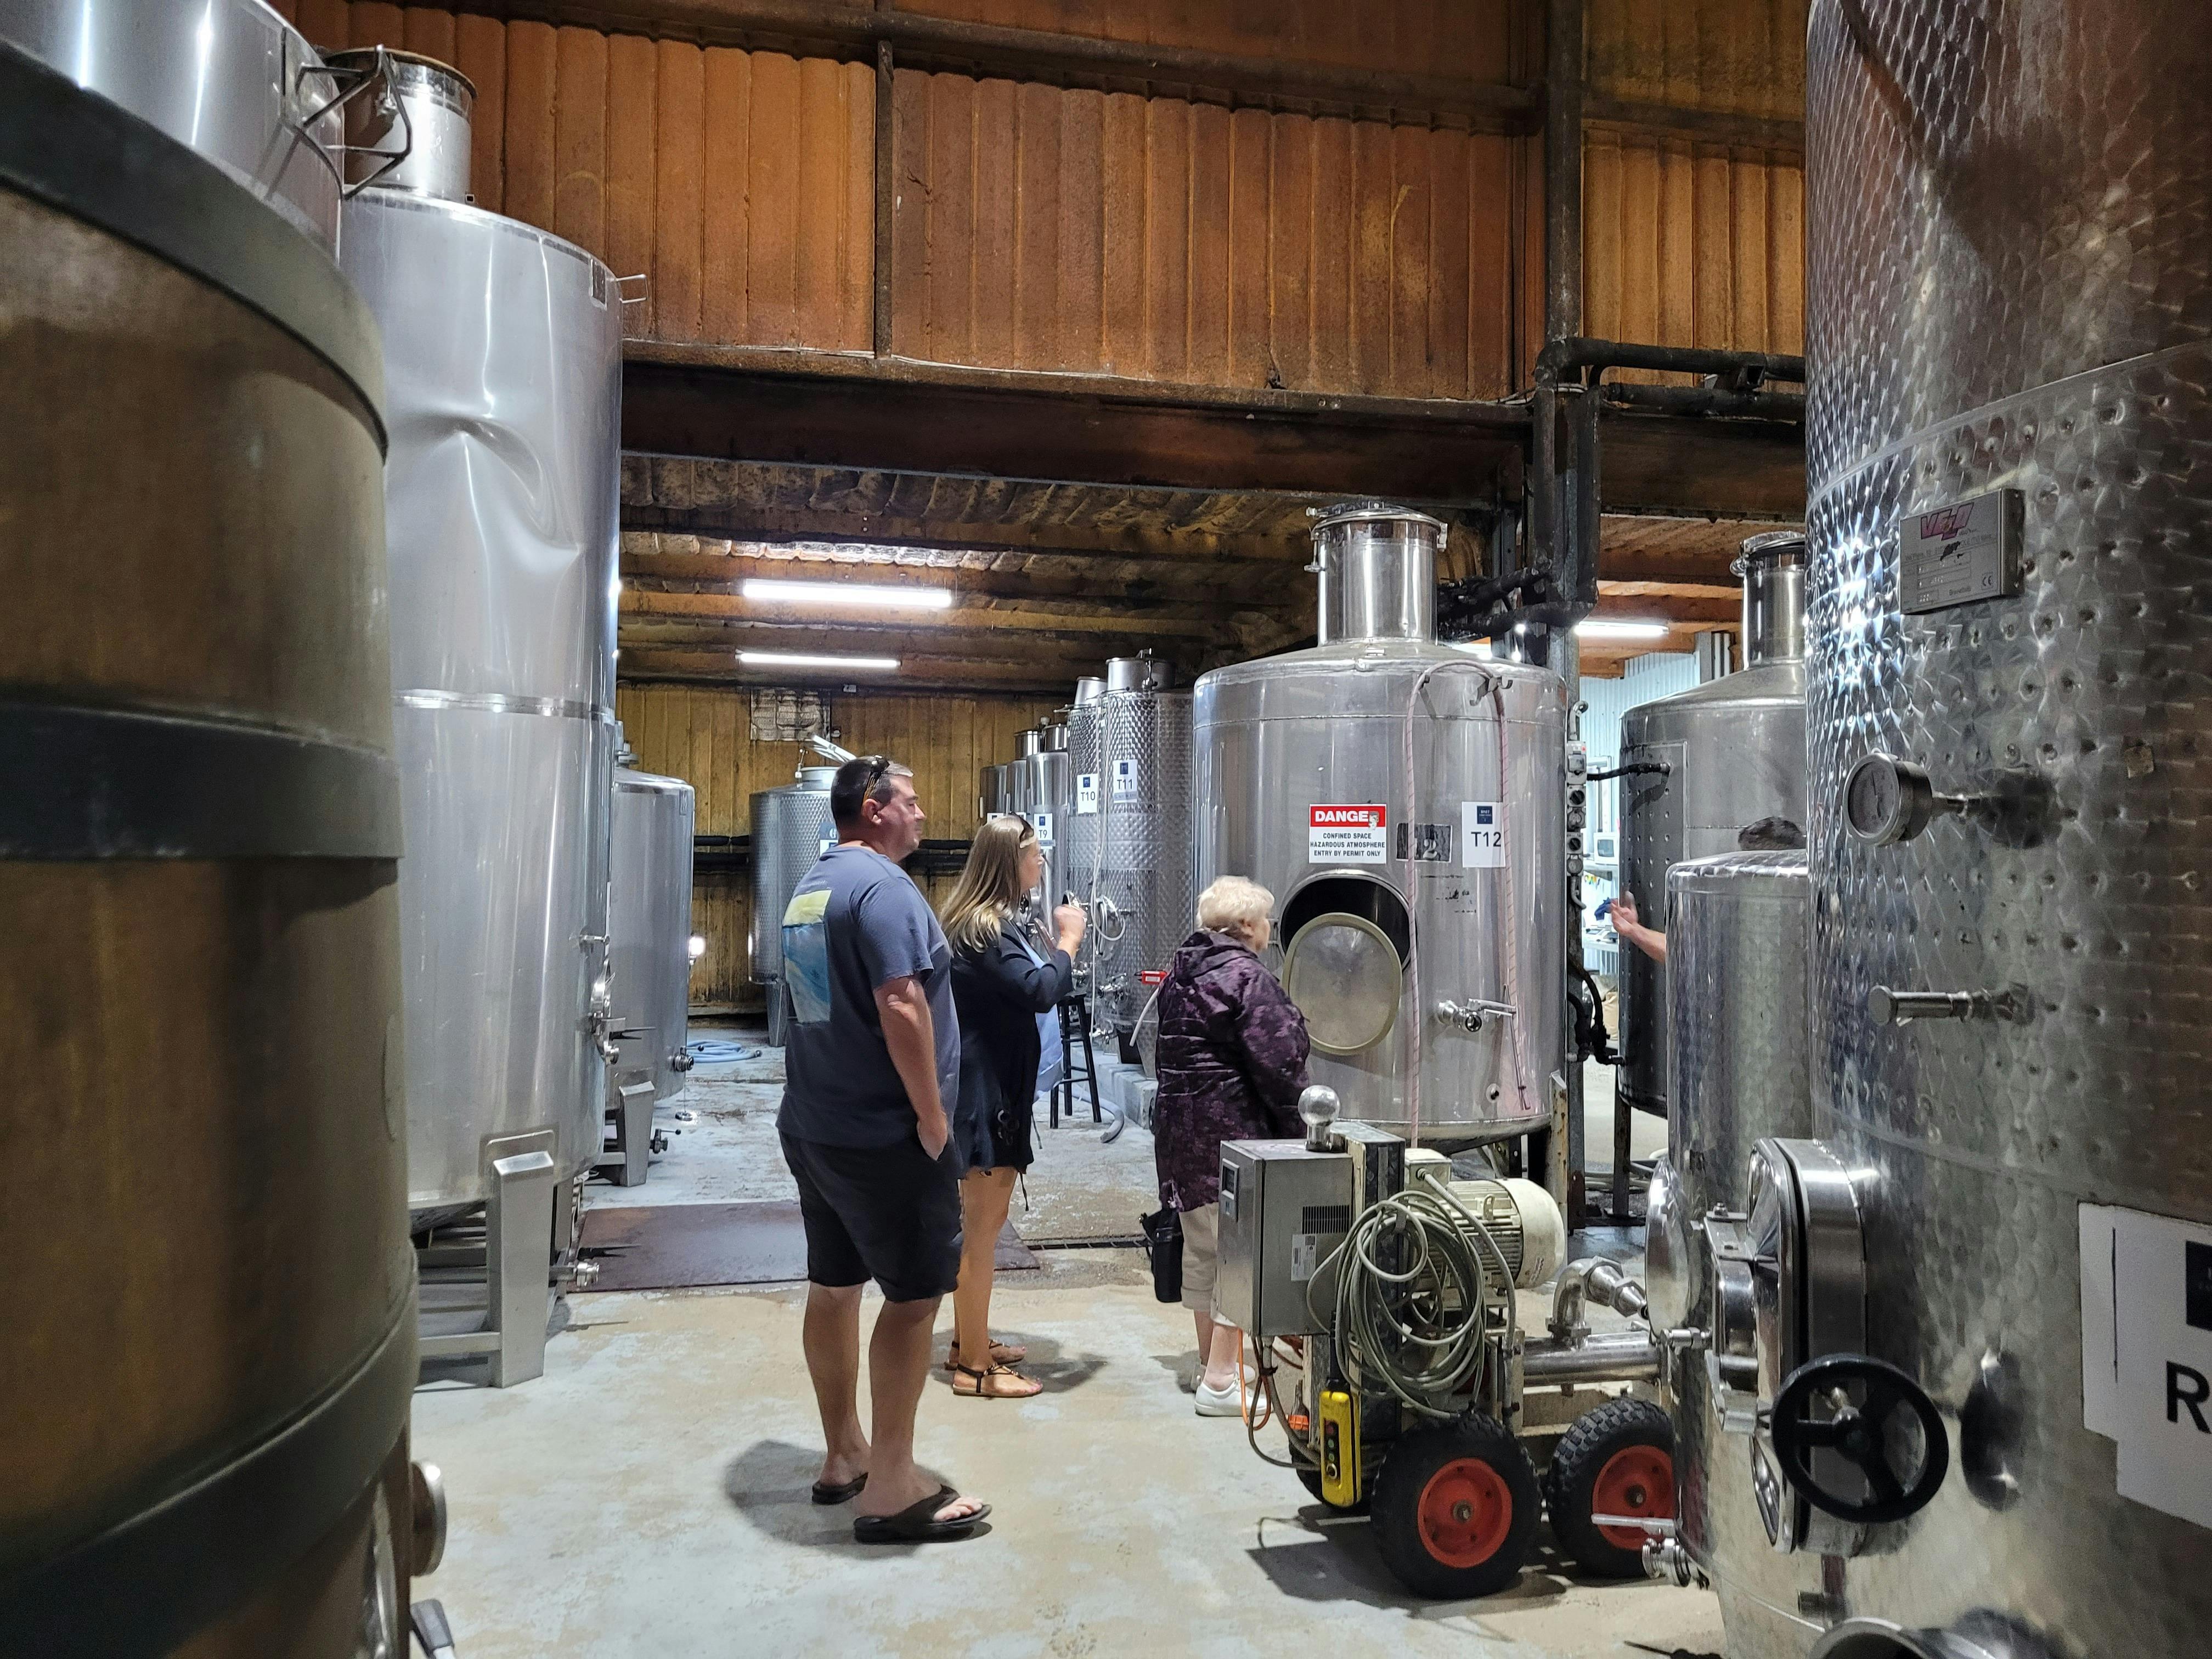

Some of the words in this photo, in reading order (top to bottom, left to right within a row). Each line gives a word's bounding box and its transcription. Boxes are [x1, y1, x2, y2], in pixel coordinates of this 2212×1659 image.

[1116, 779, 1132, 790] T11
[1080, 791, 1096, 802] T10
[1315, 810, 1379, 822] DANGE
[1039, 830, 1047, 838] T9
[1471, 831, 1502, 847] T12
